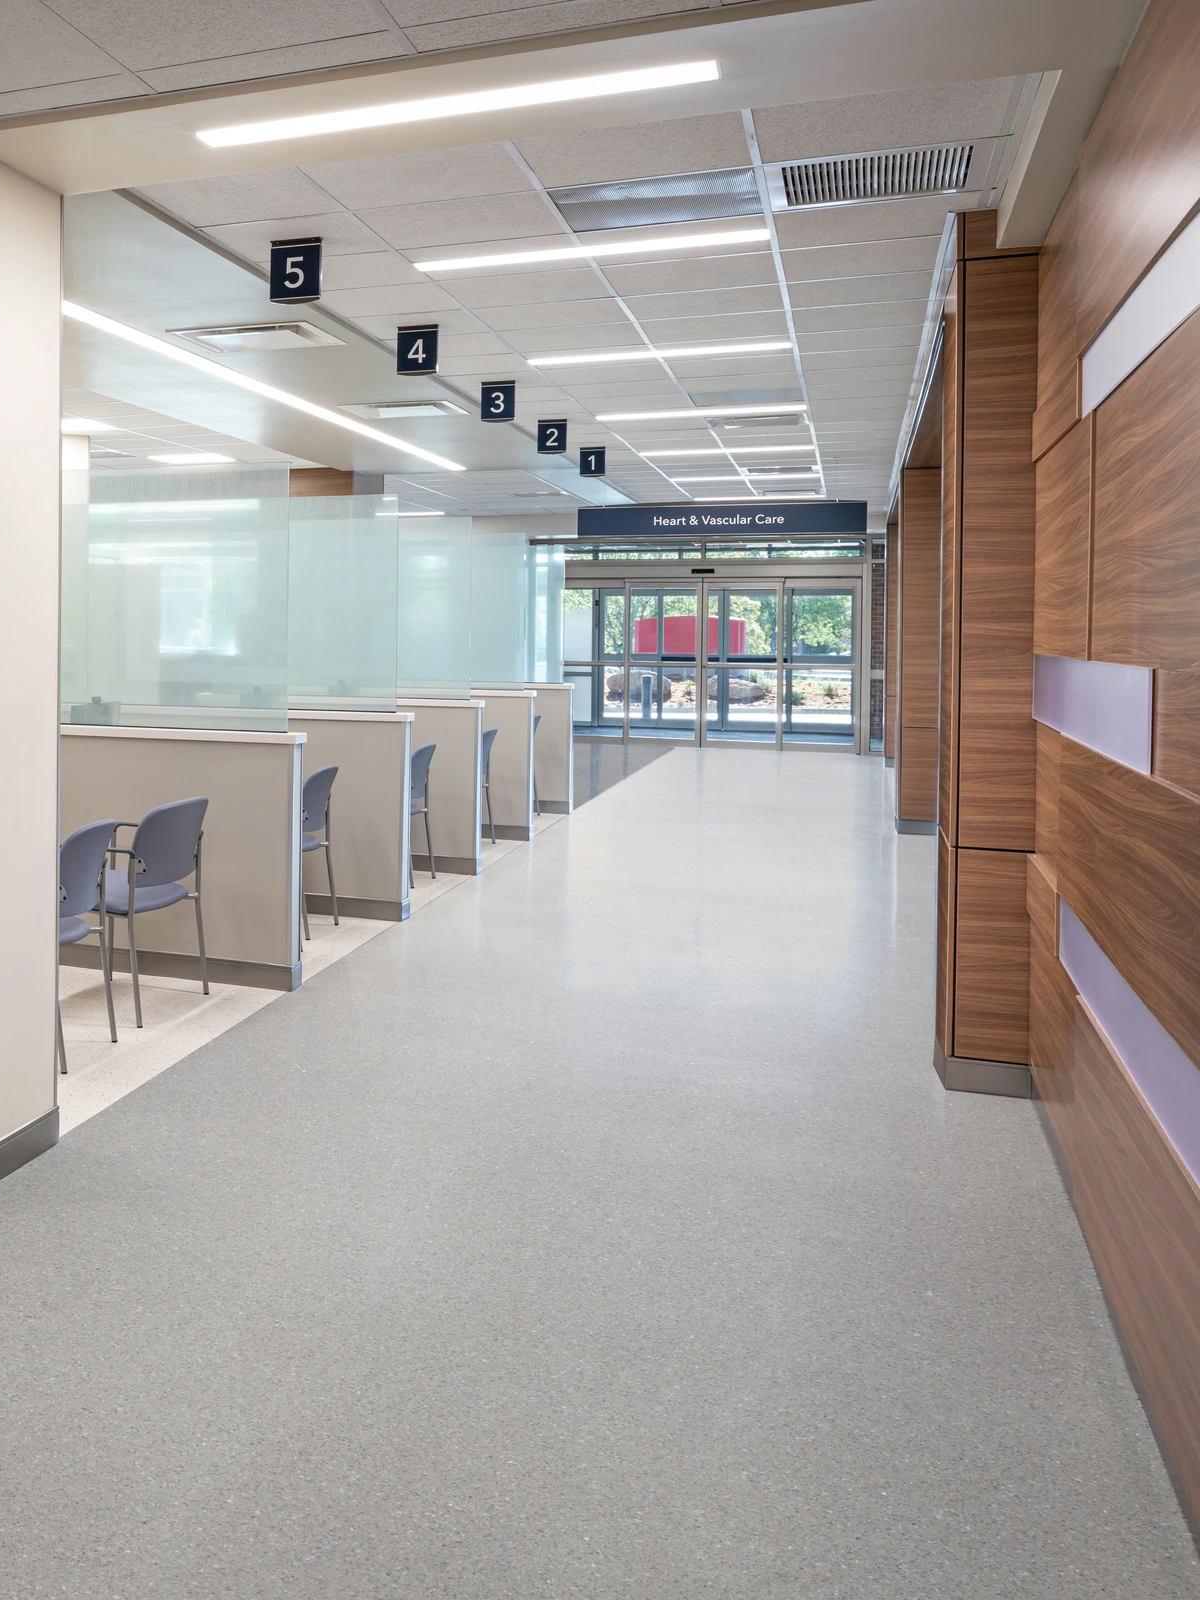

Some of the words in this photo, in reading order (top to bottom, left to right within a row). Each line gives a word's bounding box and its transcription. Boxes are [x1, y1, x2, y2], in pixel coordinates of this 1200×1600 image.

[283, 256, 305, 289] 5
[407, 339, 427, 363] 4
[489, 392, 505, 413] 3
[546, 428, 559, 446] 2
[587, 455, 596, 470] 1
[653, 515, 687, 526] Heart
[689, 515, 699, 526] &
[701, 514, 752, 526] Vascular
[755, 513, 785, 525] Care
